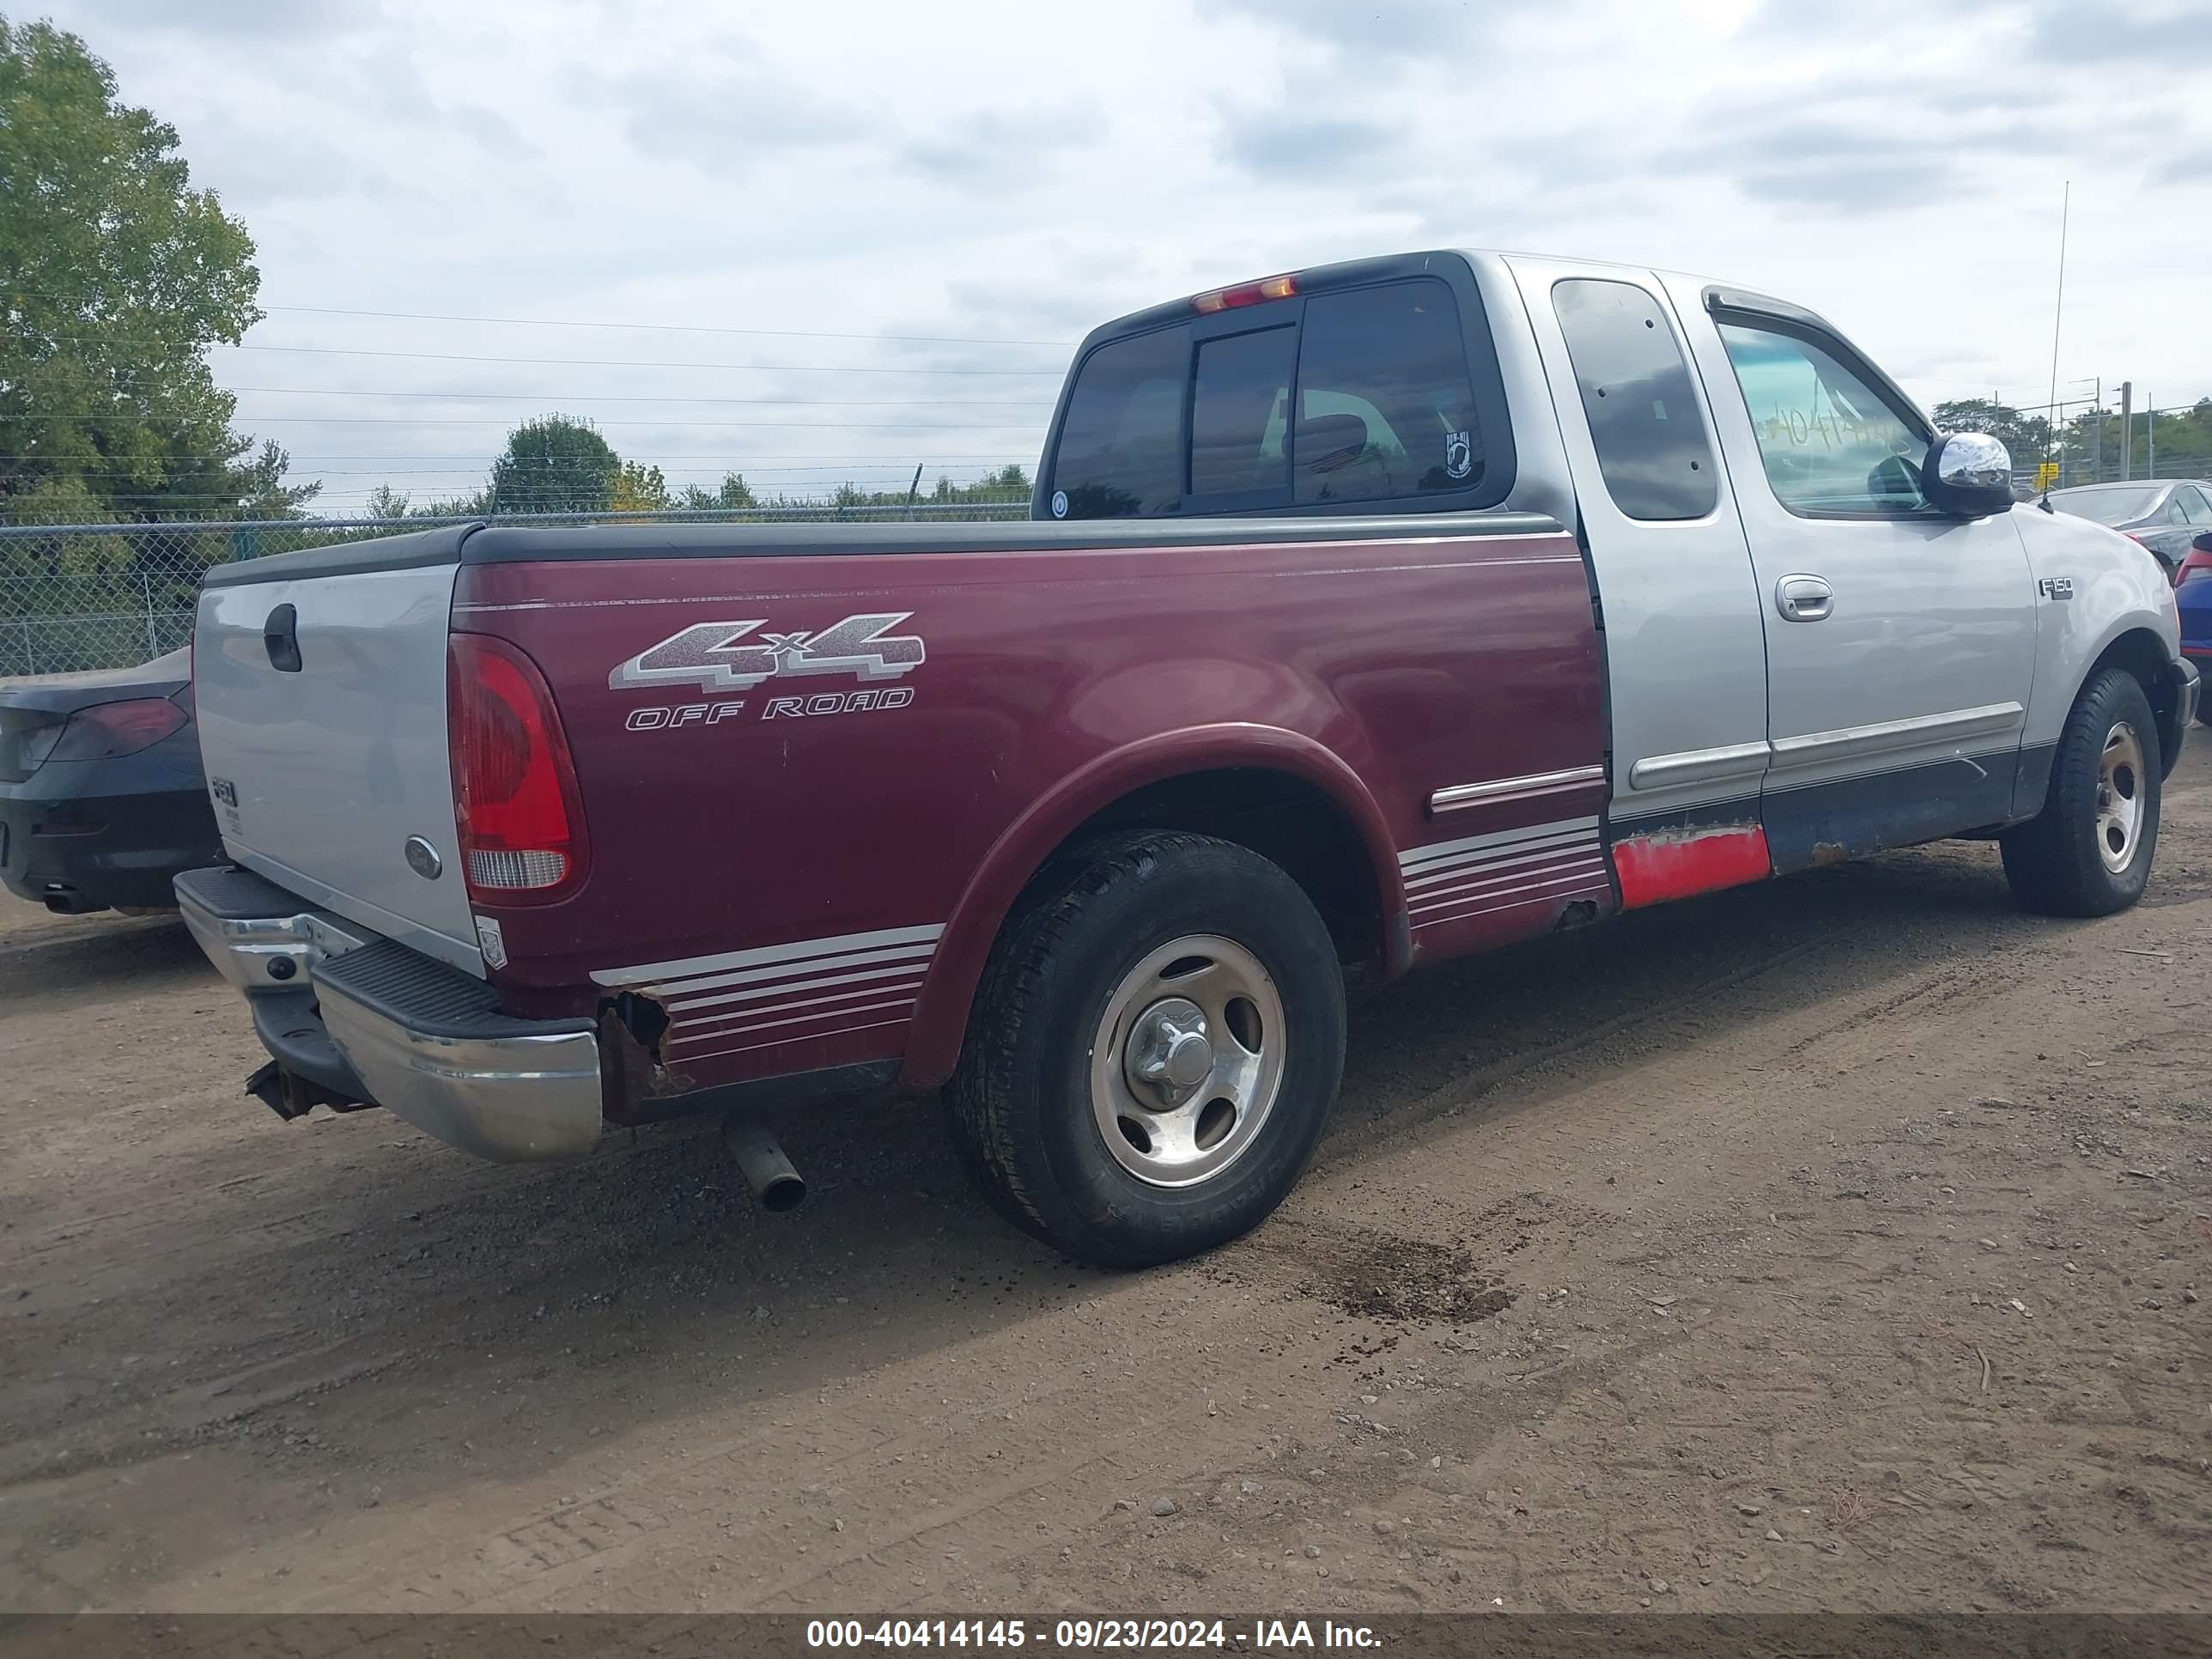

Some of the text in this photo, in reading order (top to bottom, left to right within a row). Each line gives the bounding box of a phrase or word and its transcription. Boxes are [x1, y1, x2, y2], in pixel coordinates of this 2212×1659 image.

[2039, 577, 2073, 599] F150
[625, 687, 915, 731] OFF ROAD
